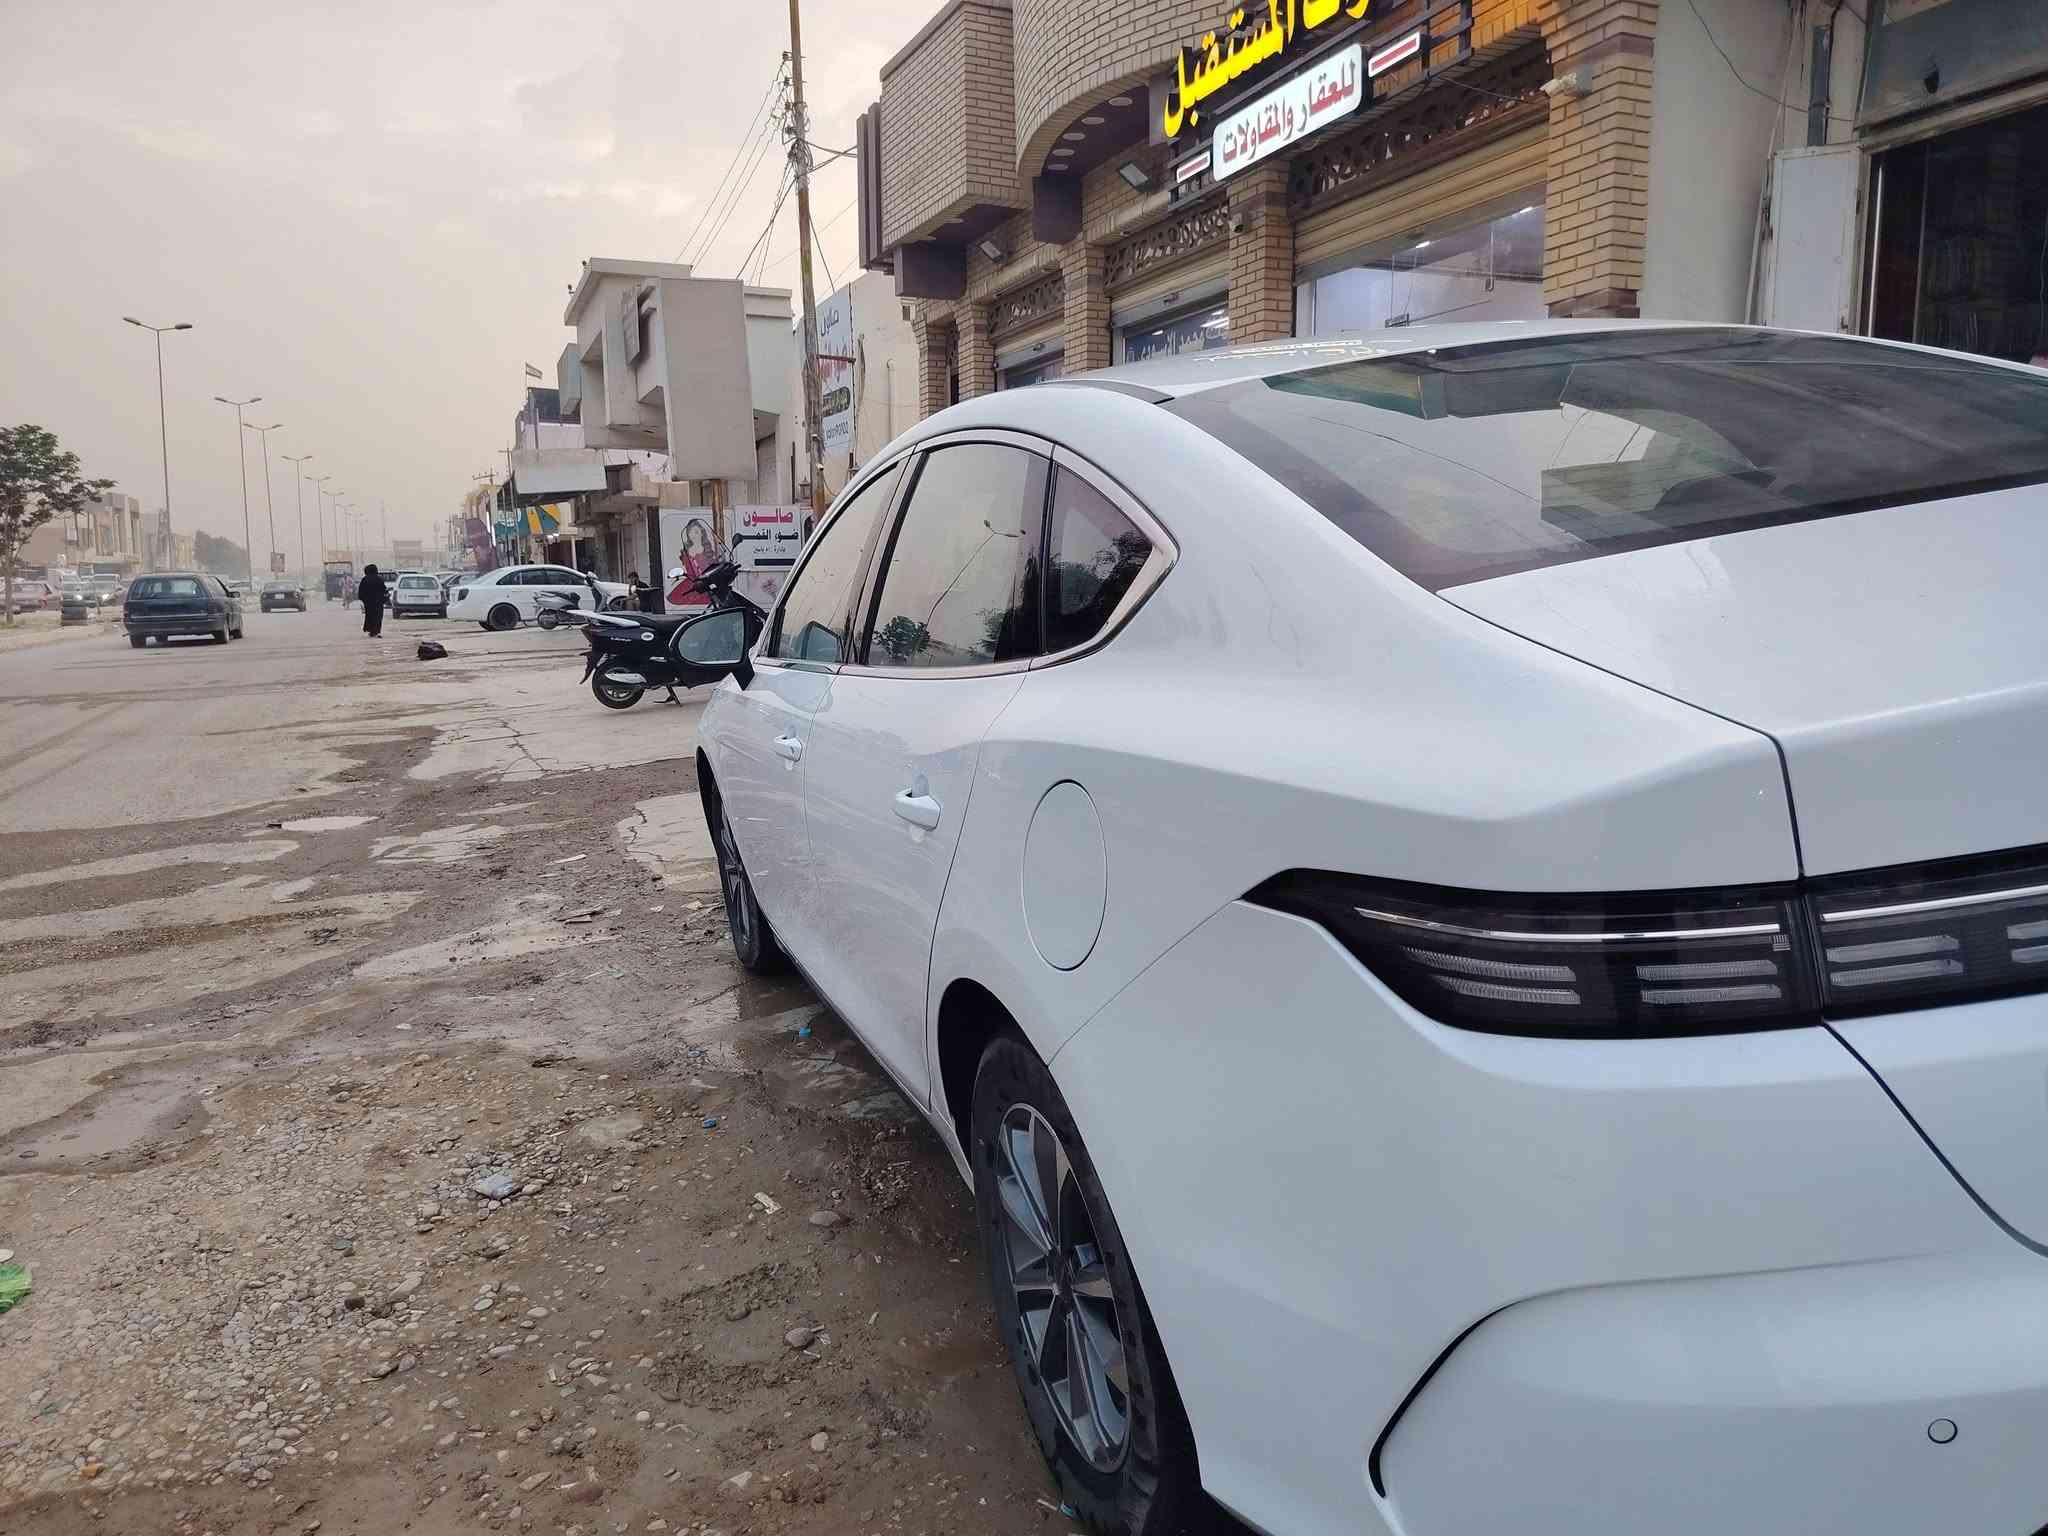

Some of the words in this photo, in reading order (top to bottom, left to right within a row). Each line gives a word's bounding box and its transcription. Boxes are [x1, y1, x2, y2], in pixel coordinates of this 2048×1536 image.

[1163, 0, 1295, 137] المستقبل
[1297, 59, 1356, 131] للعقار
[1222, 99, 1294, 163] والمقاولات
[743, 508, 793, 527] صالون
